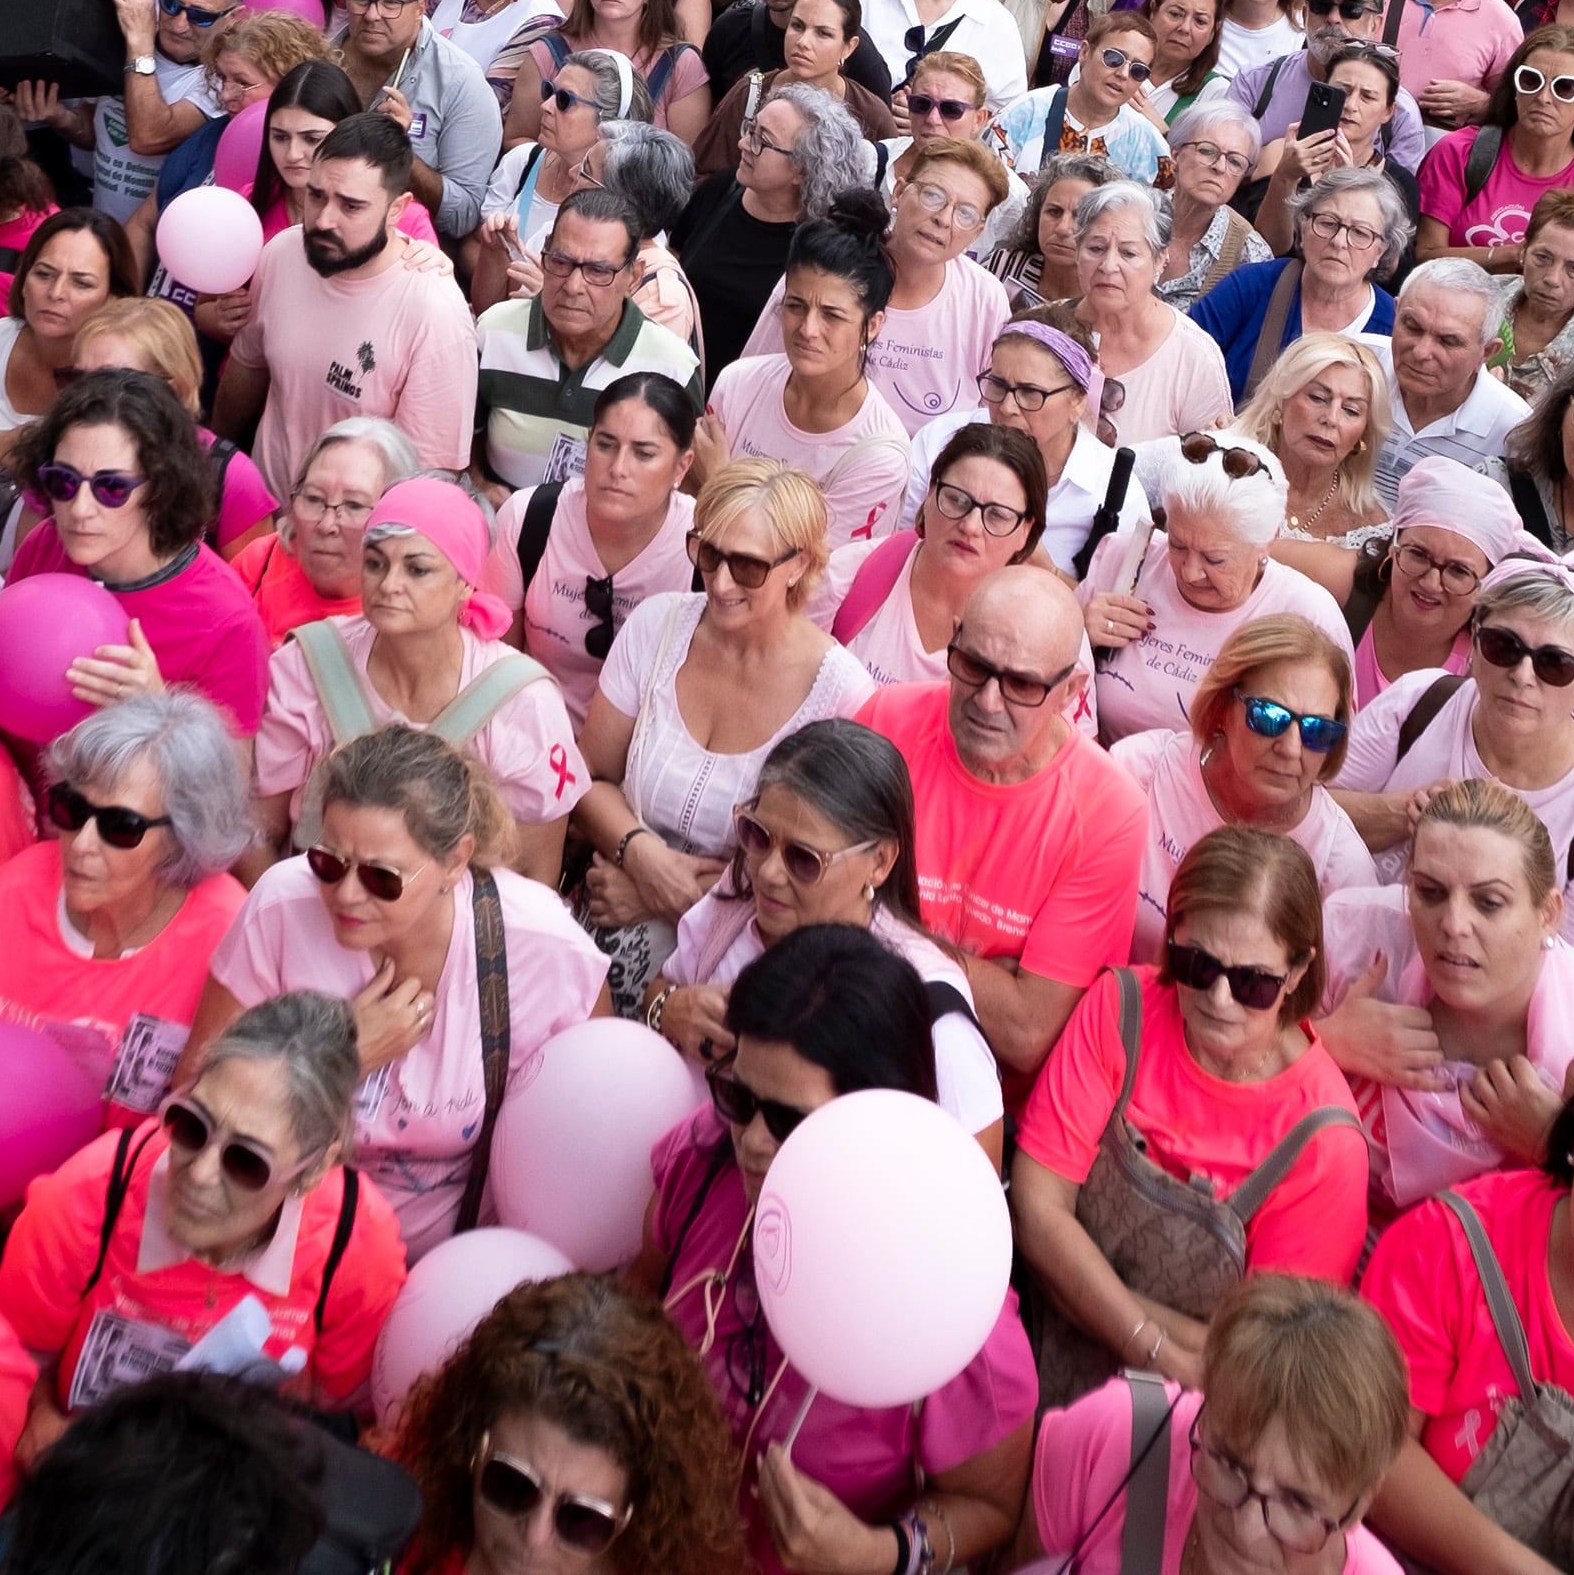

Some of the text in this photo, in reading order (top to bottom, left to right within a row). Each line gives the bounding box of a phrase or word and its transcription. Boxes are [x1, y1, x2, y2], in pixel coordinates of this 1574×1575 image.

[887, 339, 944, 360] Feministas
[329, 361, 353, 381] PALM
[880, 355, 909, 371] Cádiz
[325, 372, 362, 399] SPRINGS
[1146, 655, 1198, 683] de Cádiz
